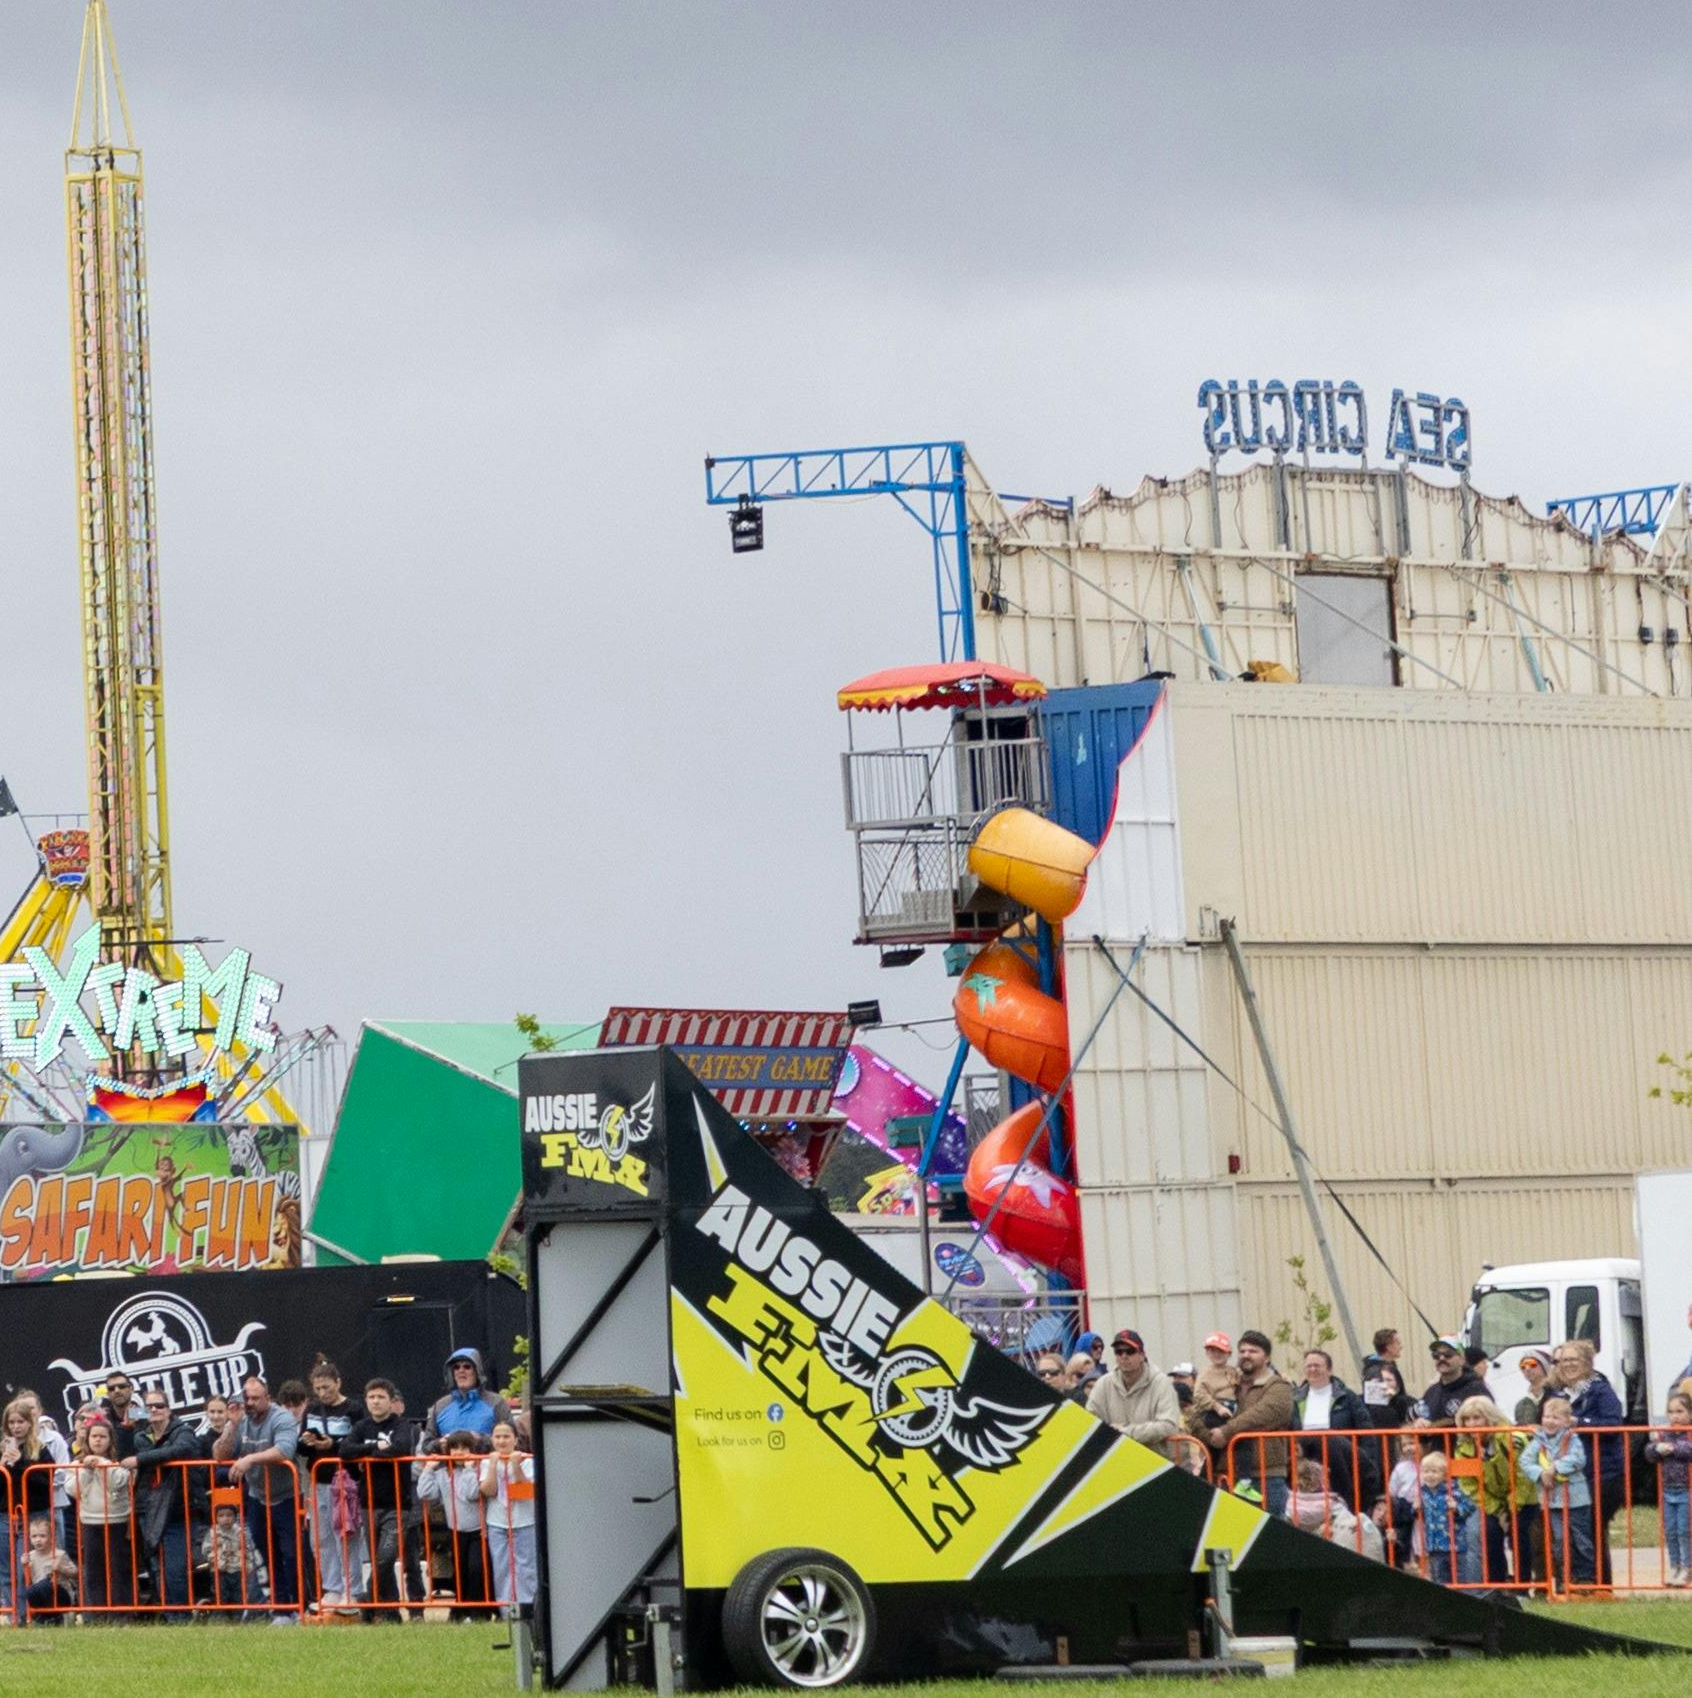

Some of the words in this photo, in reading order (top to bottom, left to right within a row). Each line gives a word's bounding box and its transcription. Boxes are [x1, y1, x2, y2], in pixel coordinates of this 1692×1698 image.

[679, 1053, 767, 1081] EATEST
[770, 1055, 834, 1082] GAME
[524, 1093, 600, 1134] AUSSIE
[540, 1132, 649, 1198] FMX
[177, 1174, 278, 1270] FUN
[695, 1183, 900, 1357] AUSSIE
[204, 1355, 249, 1400] UP
[694, 1407, 723, 1421] Find
[726, 1410, 742, 1421] us
[744, 1410, 762, 1420] on
[706, 1262, 977, 1554] FMX
[697, 1436, 720, 1447] Look
[722, 1436, 734, 1446] for
[736, 1438, 748, 1446] us
